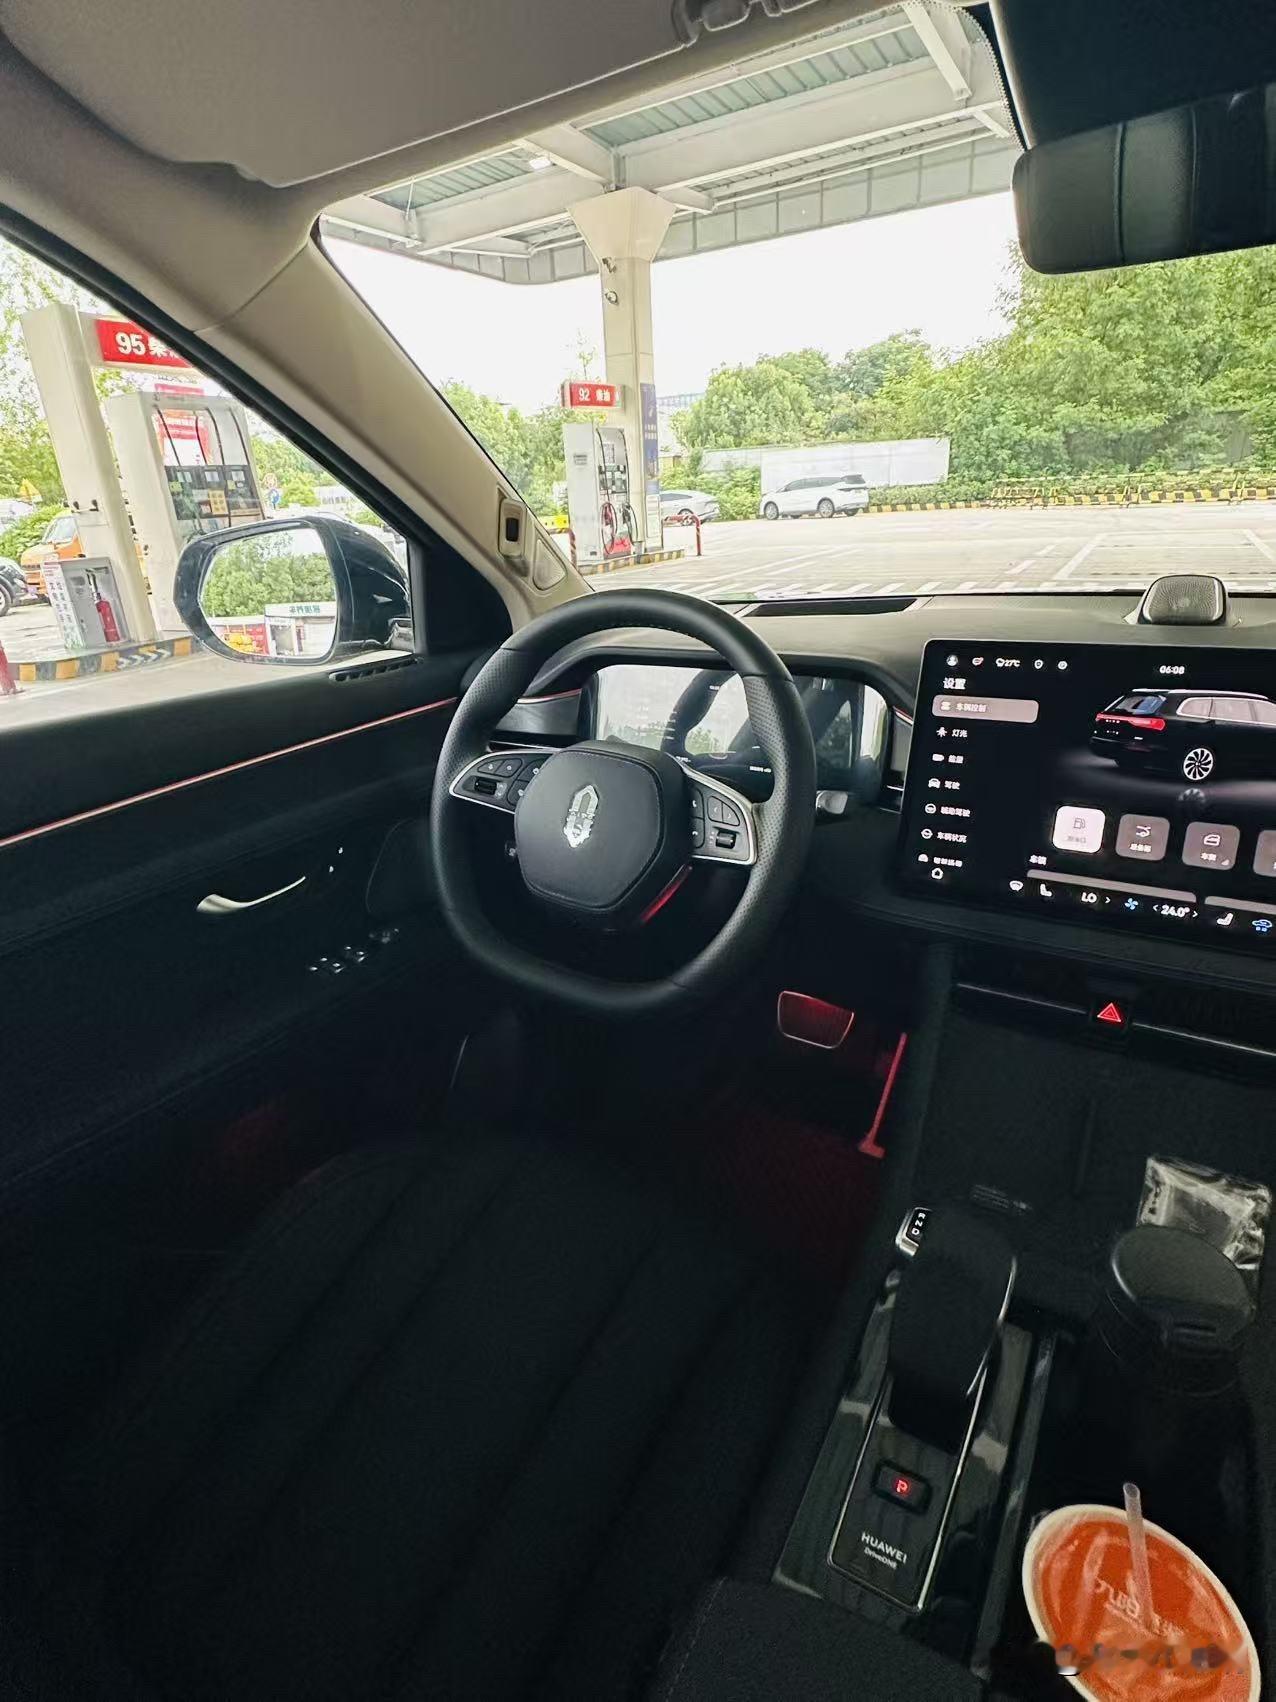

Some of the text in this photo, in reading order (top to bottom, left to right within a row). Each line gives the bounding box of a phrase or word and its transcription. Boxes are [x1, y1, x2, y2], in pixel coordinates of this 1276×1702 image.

[115, 332, 146, 355] 95
[578, 388, 591, 401] 92
[1159, 665, 1185, 675] 06:08
[943, 677, 966, 690] 设置
[951, 729, 968, 738] 灯光
[1081, 892, 1098, 903] LO
[914, 1219, 923, 1227] N
[911, 1227, 920, 1235] D
[896, 1479, 908, 1493] P
[861, 1531, 907, 1564] HUAWEI
